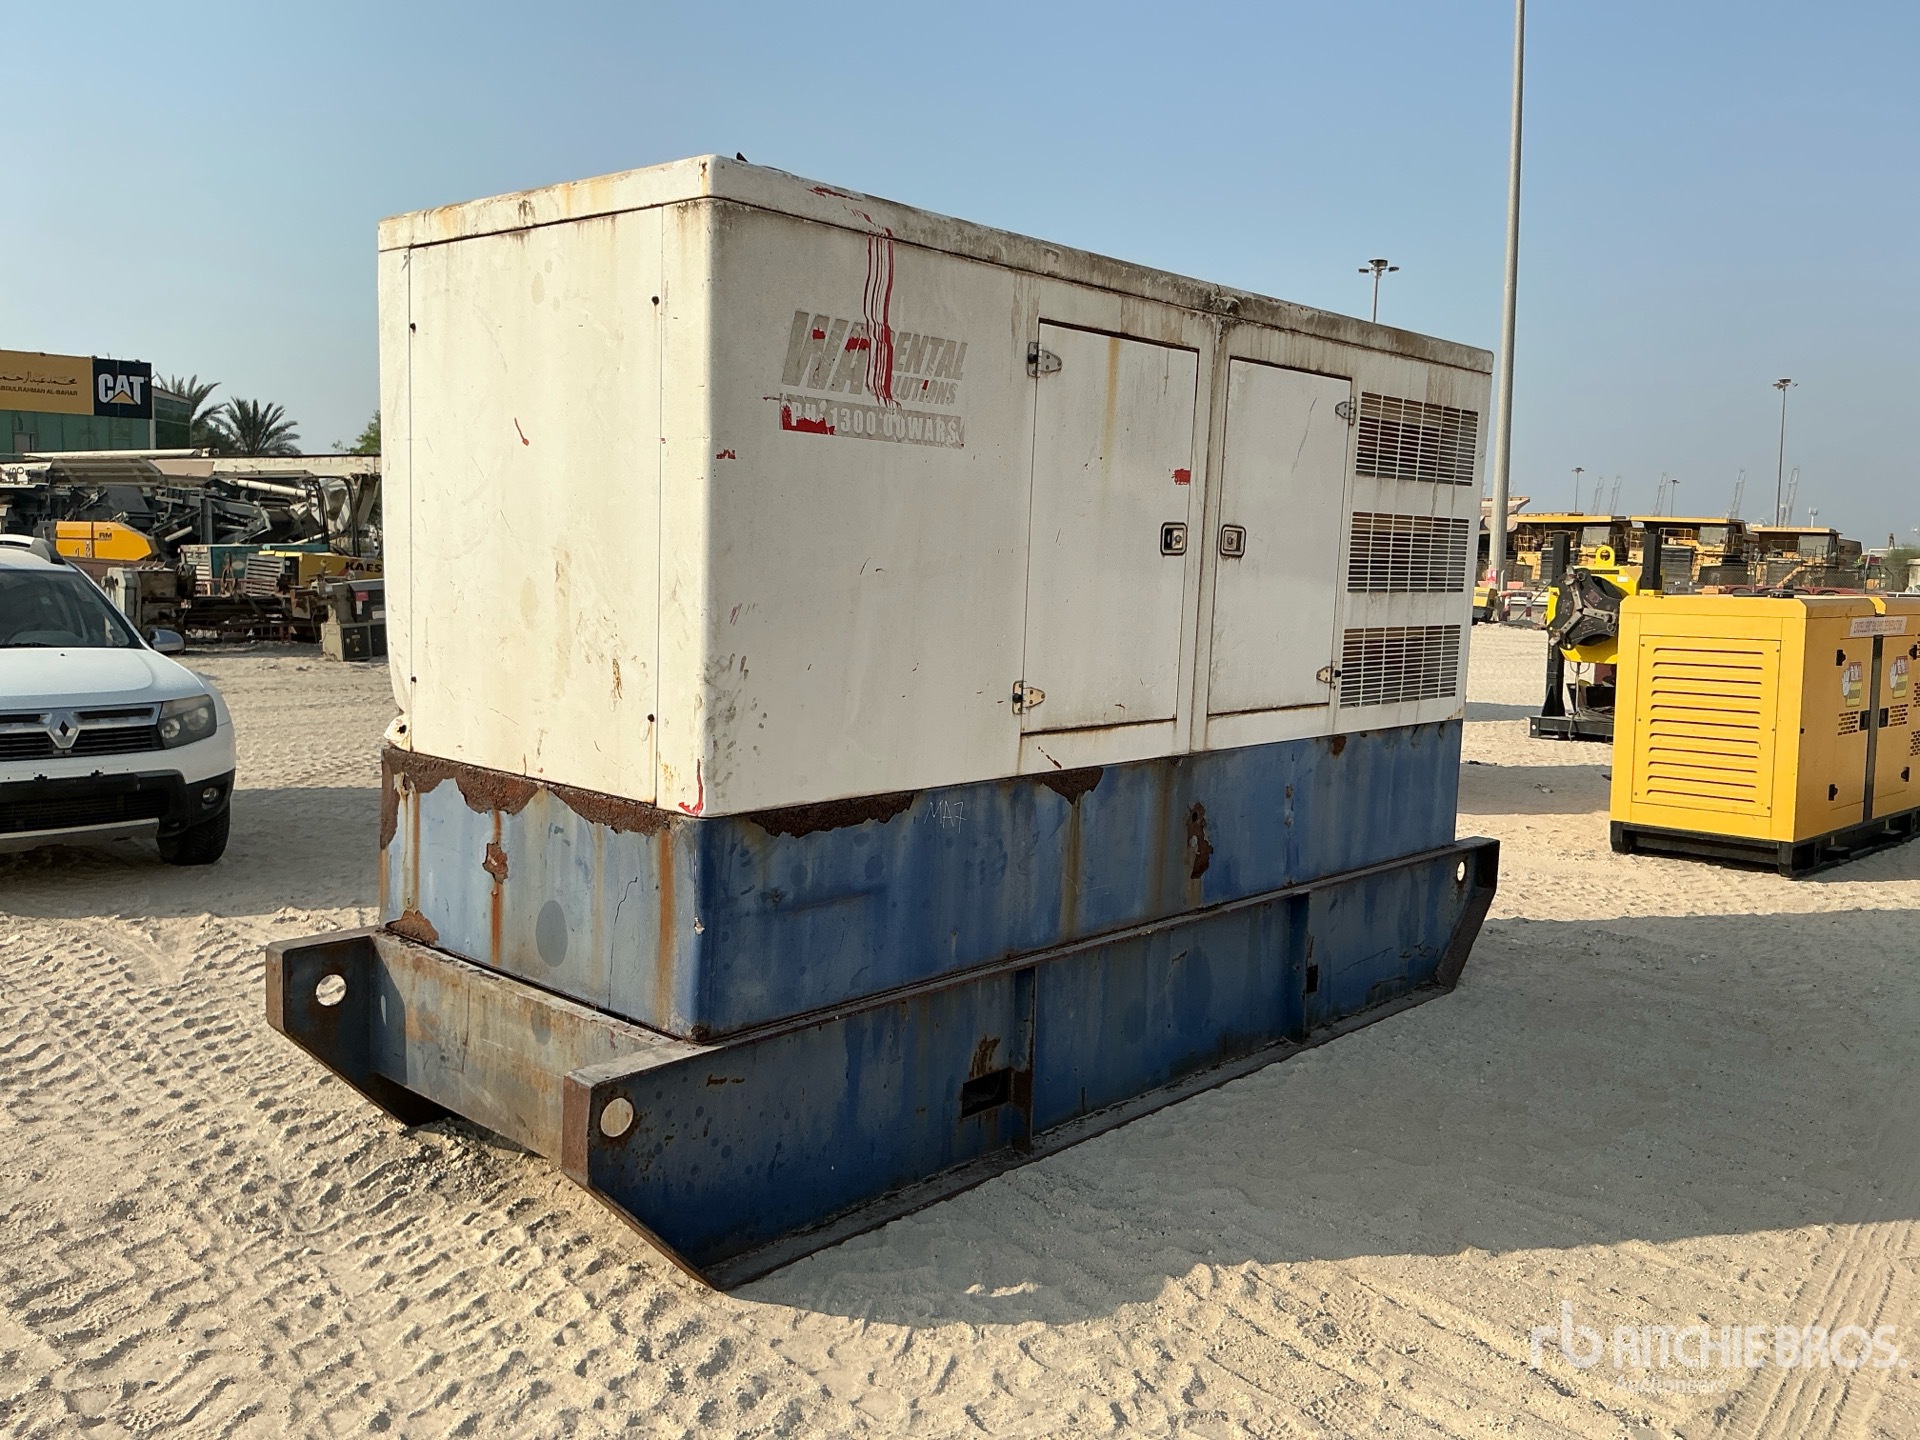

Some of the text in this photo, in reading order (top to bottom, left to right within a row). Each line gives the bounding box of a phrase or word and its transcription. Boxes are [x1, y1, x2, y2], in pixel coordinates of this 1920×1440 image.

[890, 331, 968, 380] ENTAL
[0, 384, 46, 394] BDULRAHMAN
[98, 373, 145, 405] CAT
[881, 375, 959, 405] LUTIONS
[829, 407, 876, 435] 1300
[345, 561, 383, 573] KAES
